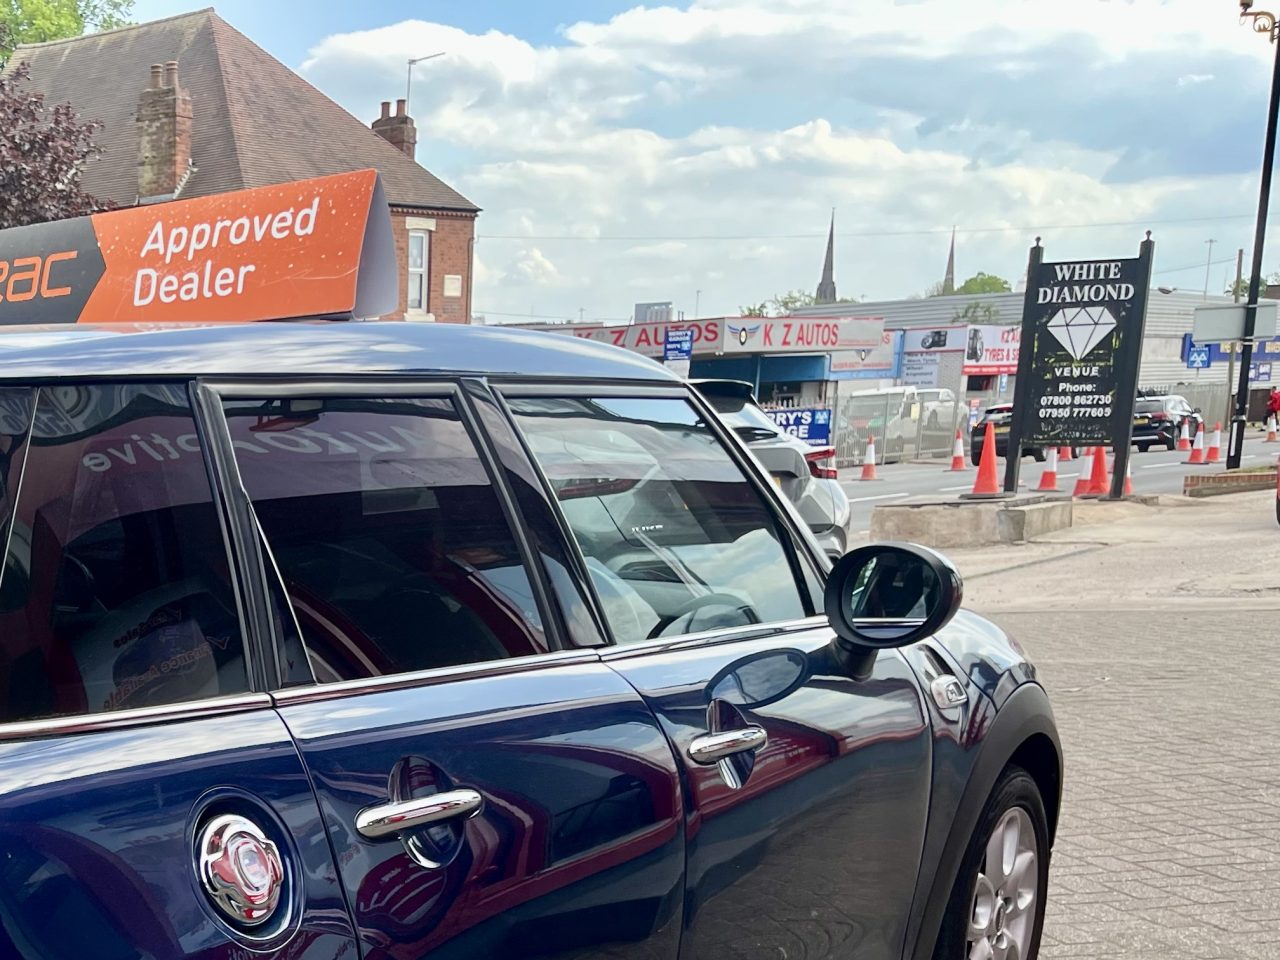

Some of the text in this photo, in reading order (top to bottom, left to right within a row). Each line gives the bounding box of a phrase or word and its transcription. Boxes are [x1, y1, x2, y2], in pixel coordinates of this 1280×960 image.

[139, 196, 321, 265] Approved
[1054, 261, 1122, 281] WHITE
[132, 260, 257, 308] Dealer
[1036, 283, 1135, 304] DIAMOND
[635, 322, 719, 348] AUOS
[763, 323, 840, 347] K Z AUTOS
[1054, 366, 1100, 377] VENUE
[1058, 382, 1097, 393] Phone:
[1040, 395, 1072, 406] 07800
